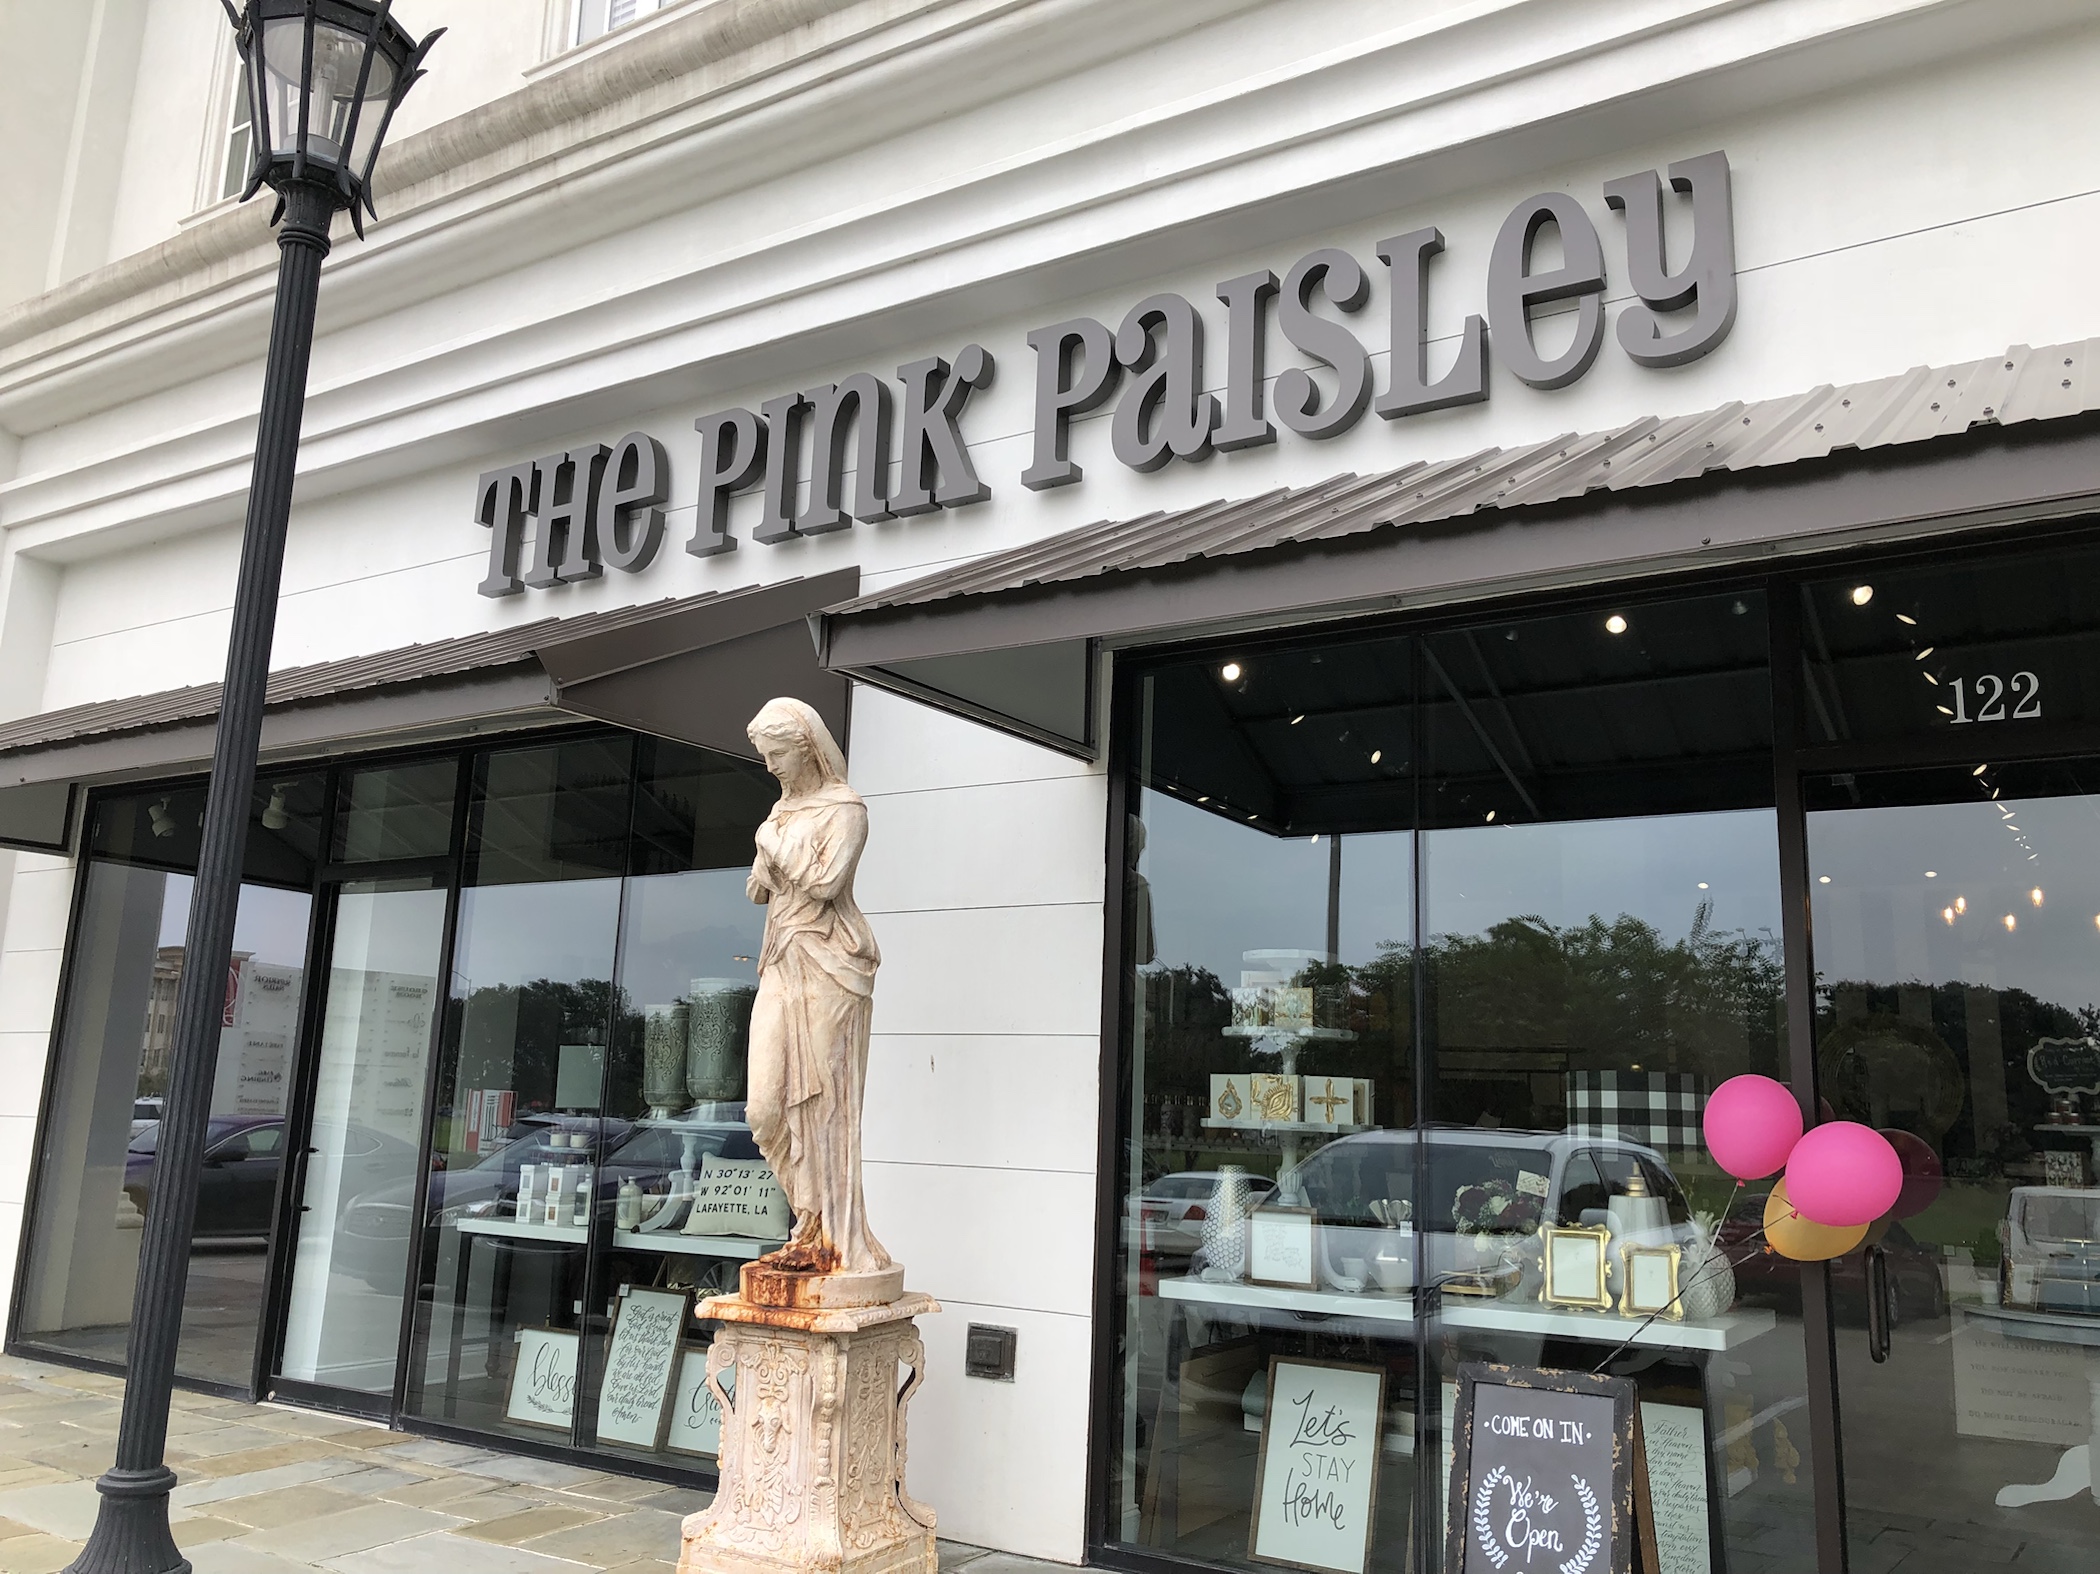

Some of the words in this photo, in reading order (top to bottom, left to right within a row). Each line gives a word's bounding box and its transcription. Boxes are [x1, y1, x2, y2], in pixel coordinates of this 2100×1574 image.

[1949, 671, 2041, 724] 122
[704, 1169, 713, 1179] N
[700, 1186, 709, 1197] W
[696, 1202, 750, 1215] LAFAYETTE,
[755, 1205, 768, 1216] LA
[1289, 1389, 1356, 1449] Let's
[1491, 1415, 1530, 1437] COME
[1532, 1417, 1555, 1440] ON
[1559, 1420, 1584, 1446] IN
[1302, 1452, 1356, 1483] STAY
[1502, 1475, 1559, 1514] We're
[1505, 1508, 1564, 1564] Open
